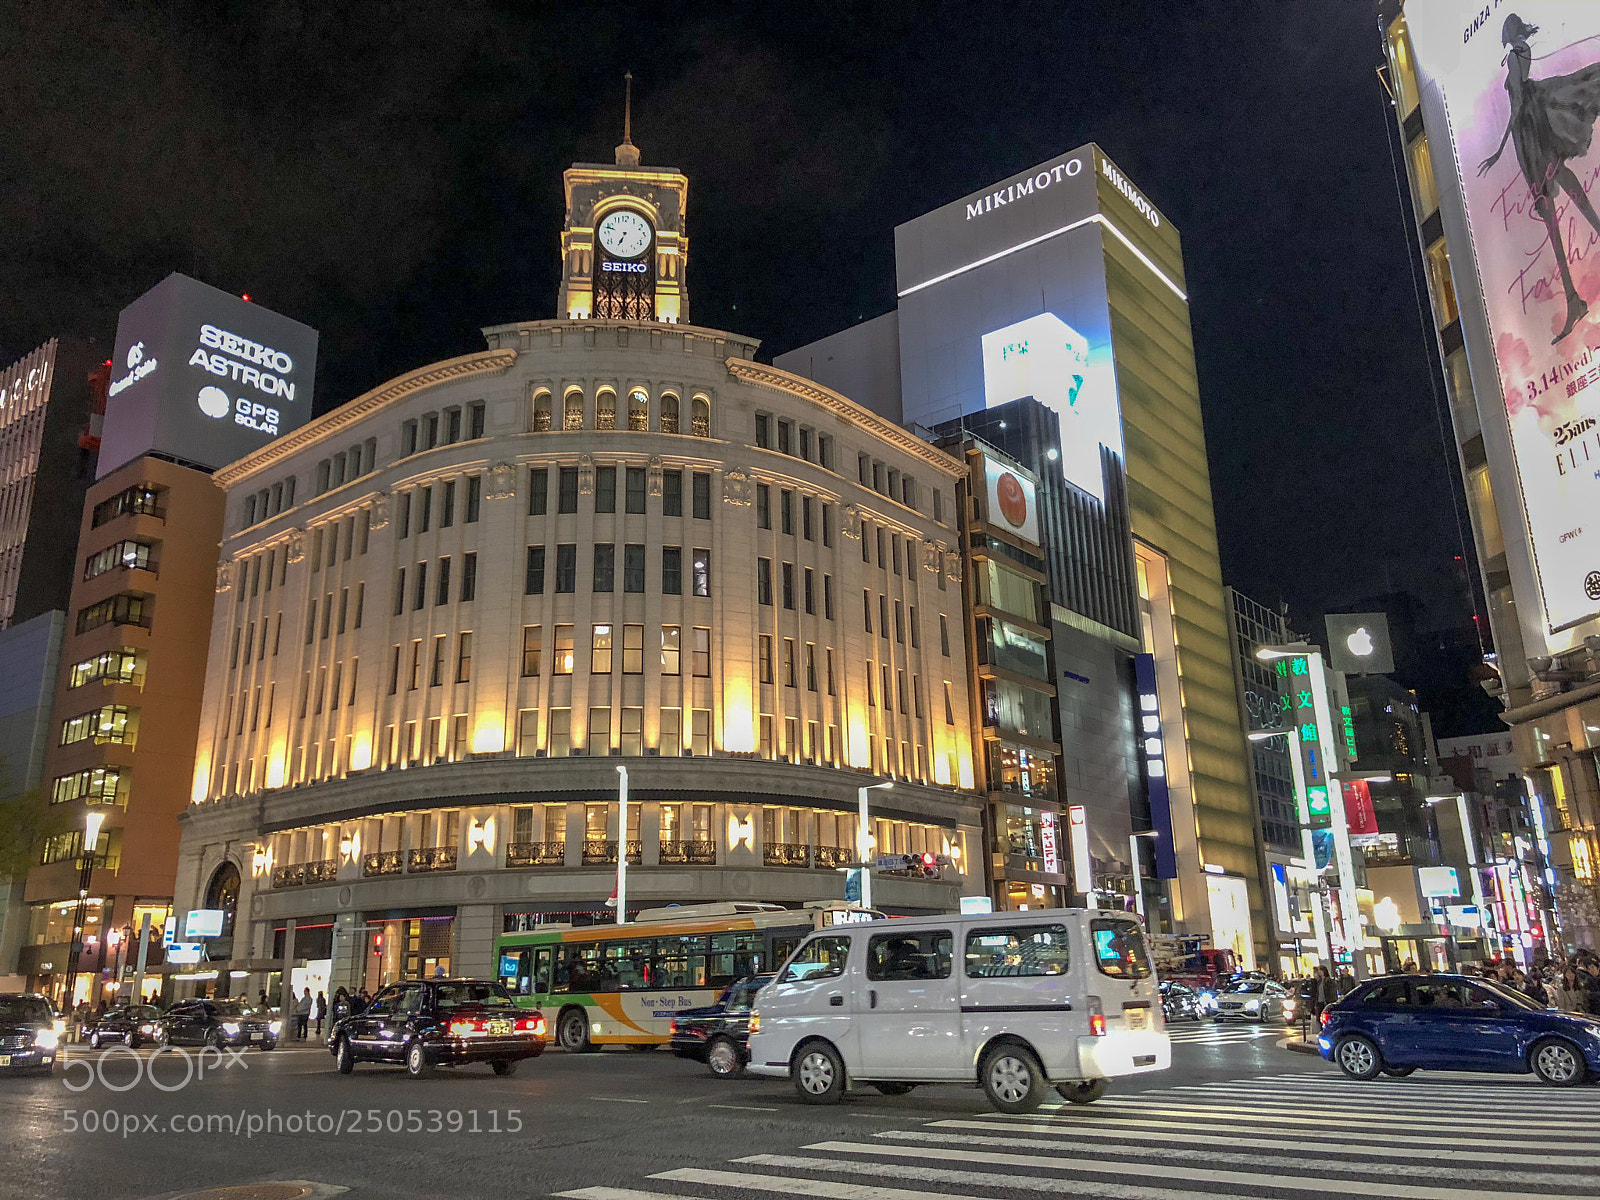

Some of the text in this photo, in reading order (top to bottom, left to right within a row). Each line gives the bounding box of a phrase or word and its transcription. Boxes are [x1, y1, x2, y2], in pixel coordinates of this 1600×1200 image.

[1463, 5, 1490, 44] GINZA
[966, 158, 1083, 221] MIKIMOTO
[1102, 159, 1160, 228] MIKIMOTO
[1490, 157, 1562, 231] Fine
[602, 262, 647, 273] SEIKO
[199, 324, 293, 374] SEIKO
[188, 349, 296, 401] ASTRON
[1565, 363, 1600, 399] 銀座三
[235, 398, 280, 425] GPS
[235, 413, 278, 436] SOLAR
[1291, 657, 1318, 742] 教文館
[678, 996, 692, 1007] Bus
